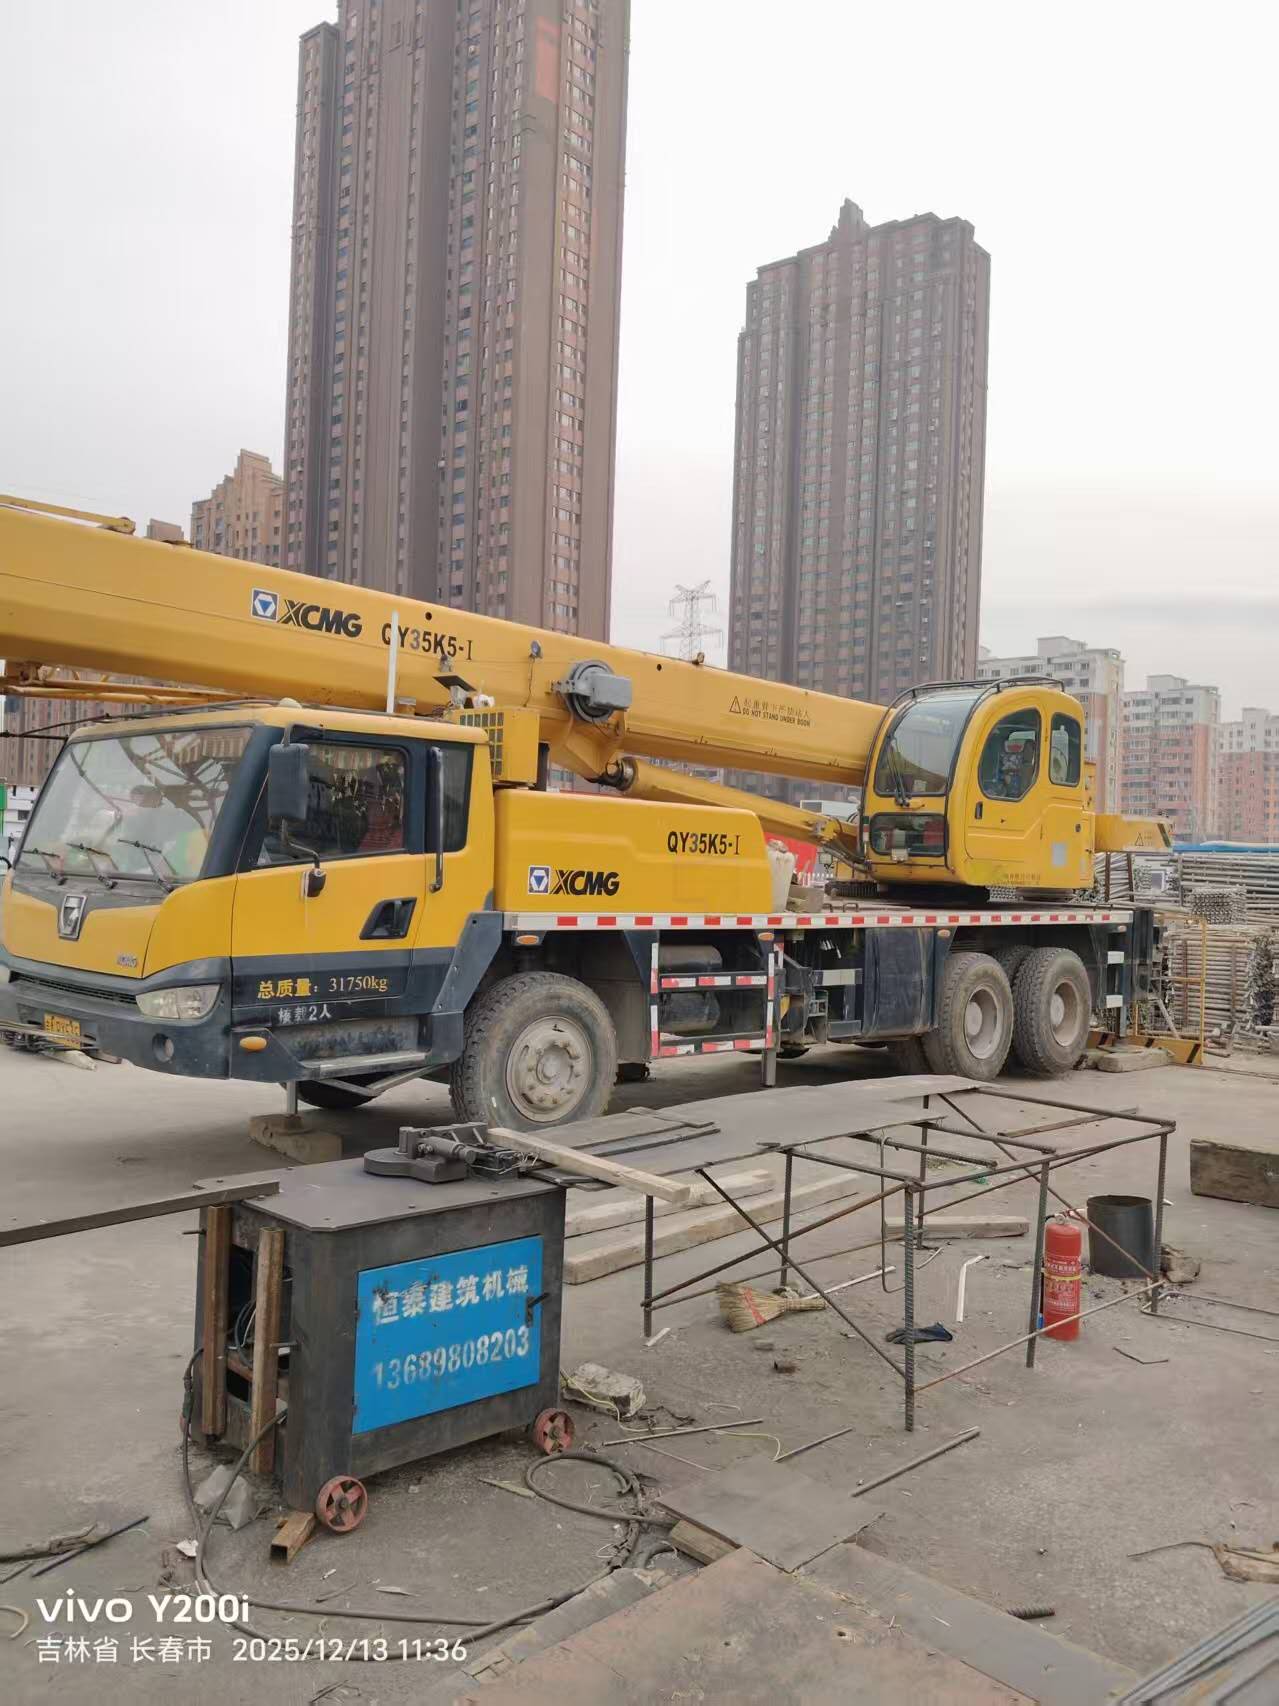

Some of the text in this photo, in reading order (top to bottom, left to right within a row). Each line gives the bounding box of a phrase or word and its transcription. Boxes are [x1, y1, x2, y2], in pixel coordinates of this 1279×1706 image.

[278, 599, 363, 638] XCMG
[551, 869, 620, 896] XCMG
[328, 975, 388, 993] 31750kg
[372, 1264, 529, 1326] 恒泰建筑机械
[374, 1324, 530, 1390] 13689808203
